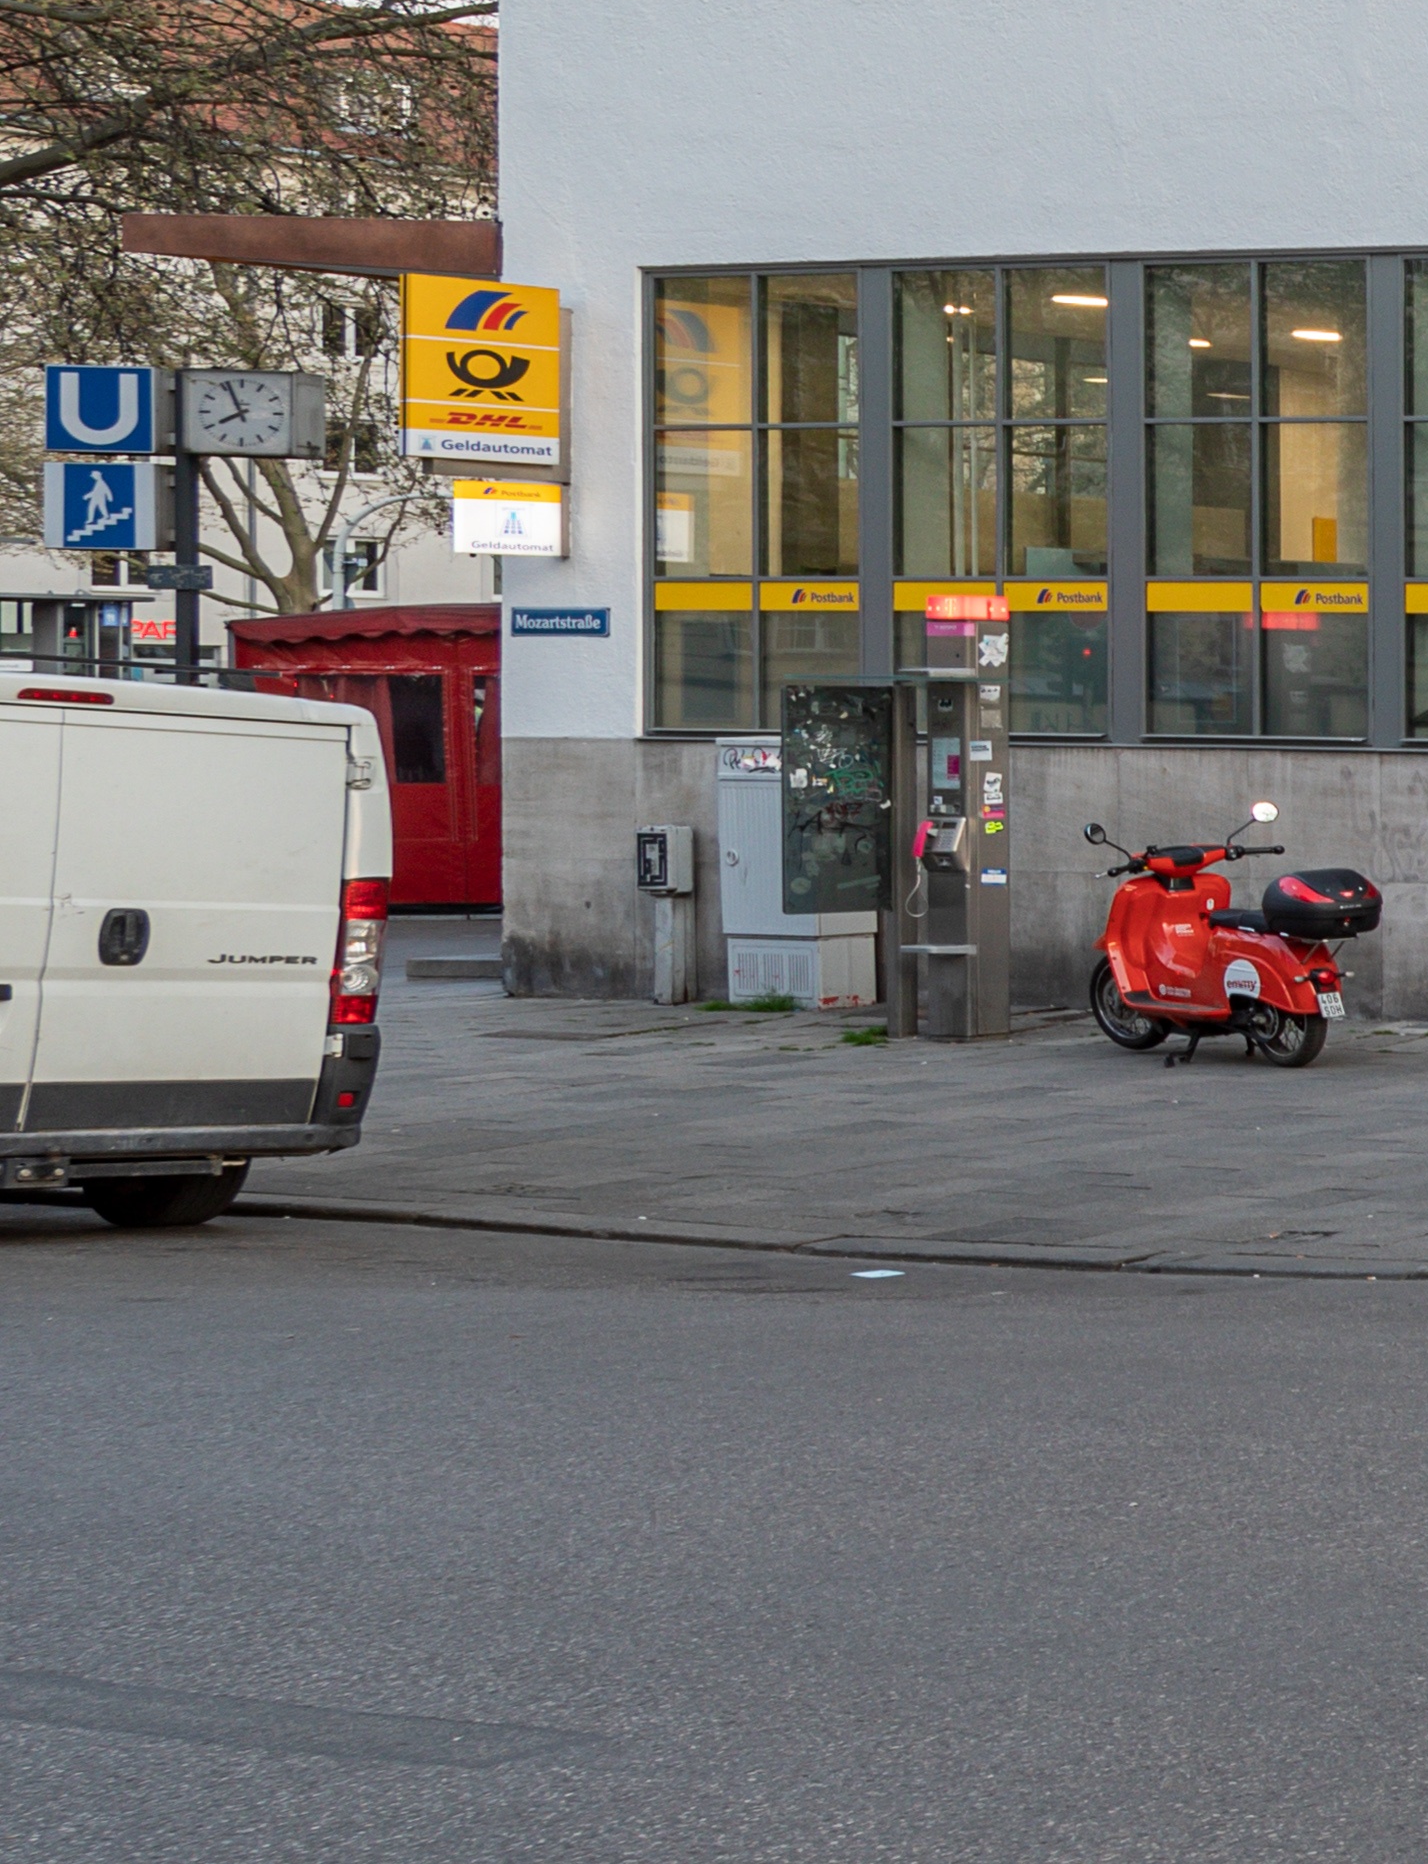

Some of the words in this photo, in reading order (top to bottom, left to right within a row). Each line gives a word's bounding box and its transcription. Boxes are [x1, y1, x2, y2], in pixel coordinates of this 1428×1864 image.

[60, 372, 139, 445] U
[446, 411, 527, 429] DHL
[441, 438, 552, 457] Geldautomat
[501, 490, 541, 498] Postbank
[471, 540, 554, 552] Geldautomat
[811, 592, 854, 603] Postbank
[1057, 592, 1102, 603] Postbank
[1315, 592, 1363, 605] Postbank
[516, 614, 601, 630] Mozartstraße
[207, 954, 318, 965] JUMPER
